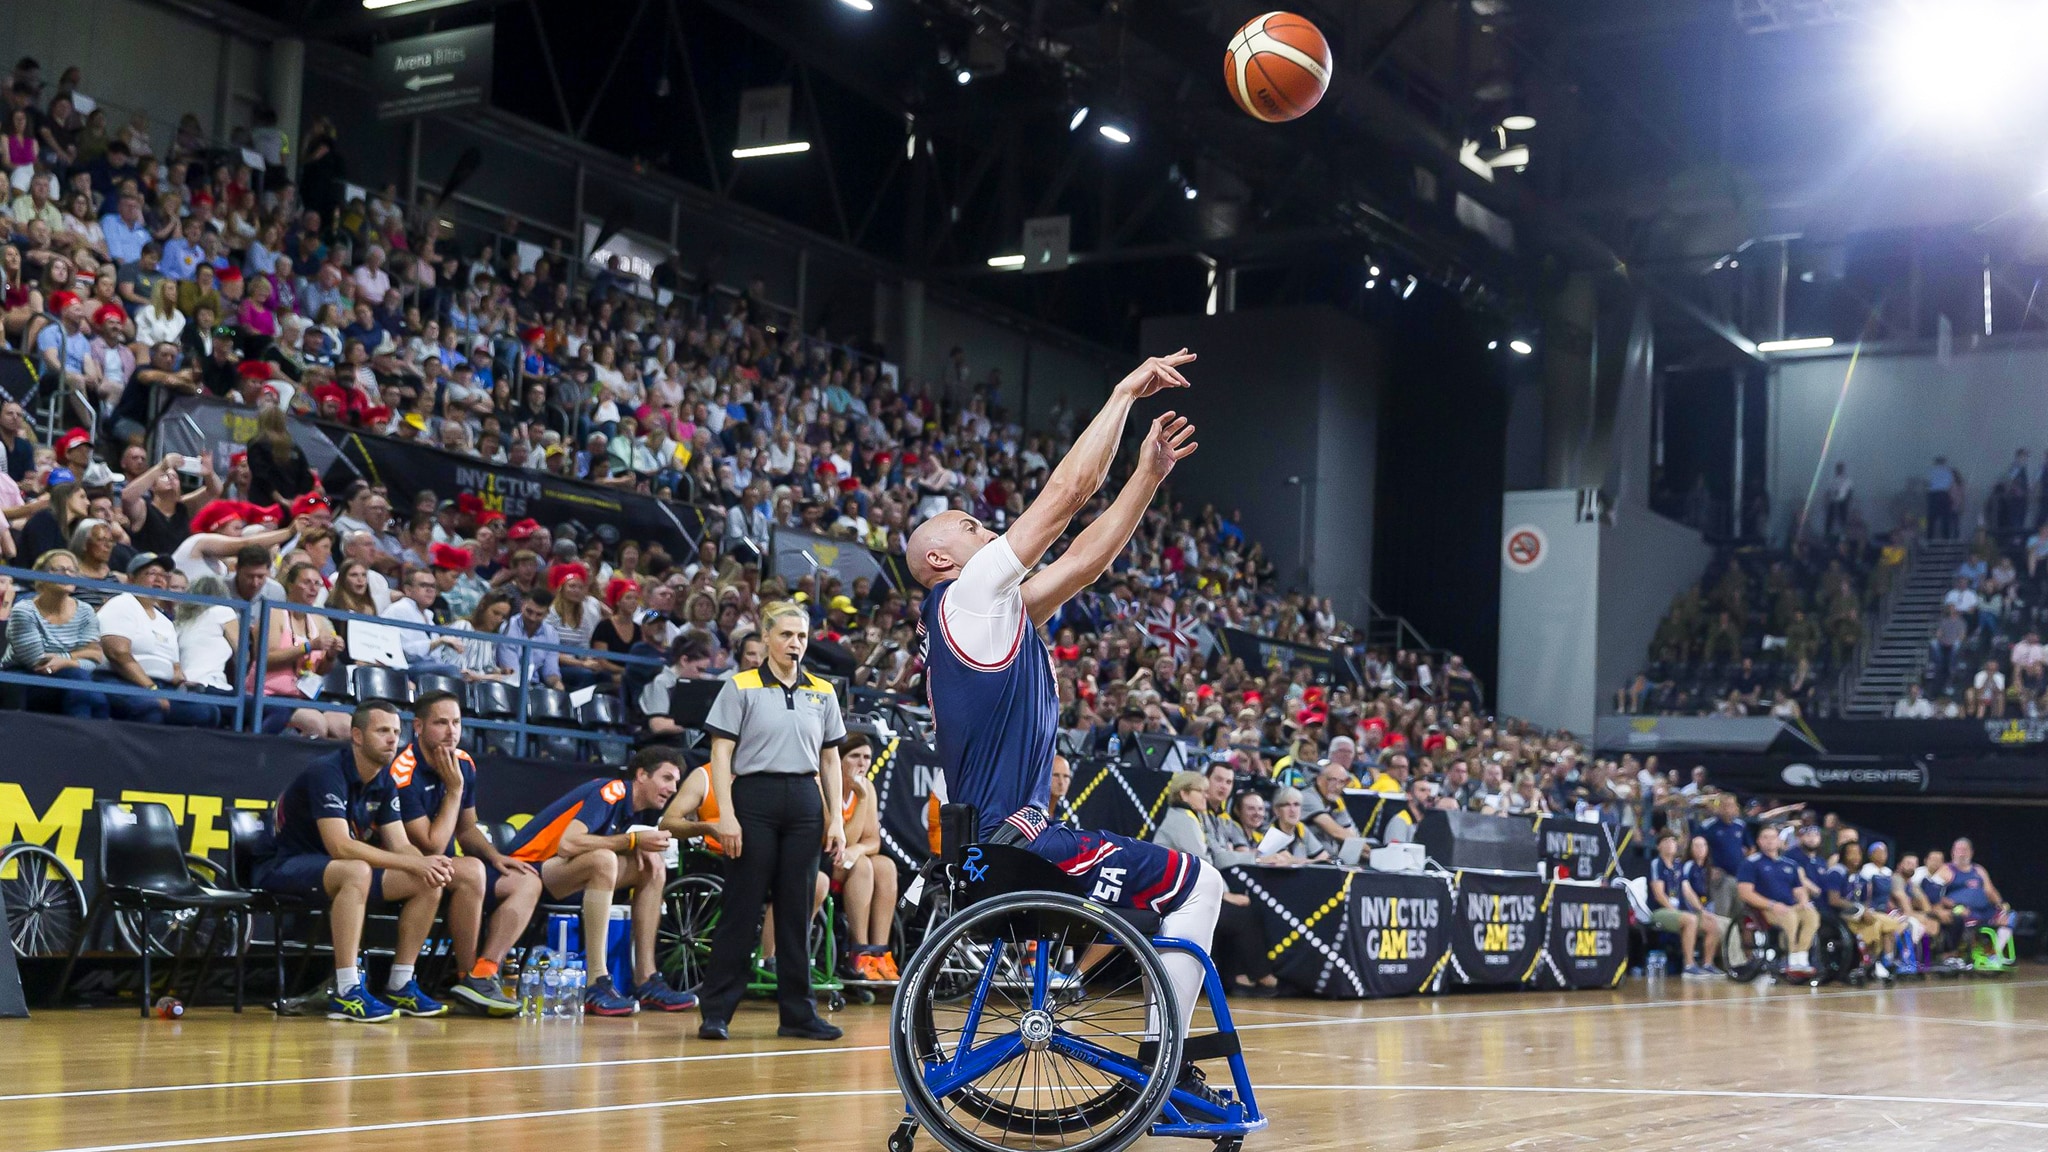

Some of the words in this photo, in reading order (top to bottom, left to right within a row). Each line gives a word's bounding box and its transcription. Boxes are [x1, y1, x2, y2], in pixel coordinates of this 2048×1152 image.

[393, 53, 432, 73] Arena
[456, 466, 542, 500] INVICTUS
[1546, 831, 1600, 857] INVICTUS
[1361, 895, 1439, 928] INVICTUS
[1468, 893, 1536, 922] INVICTUS
[1560, 902, 1621, 930] INVICTUS
[1366, 928, 1427, 960] GAMES
[1473, 922, 1526, 952] GAMES
[1565, 930, 1613, 957] GAMES
